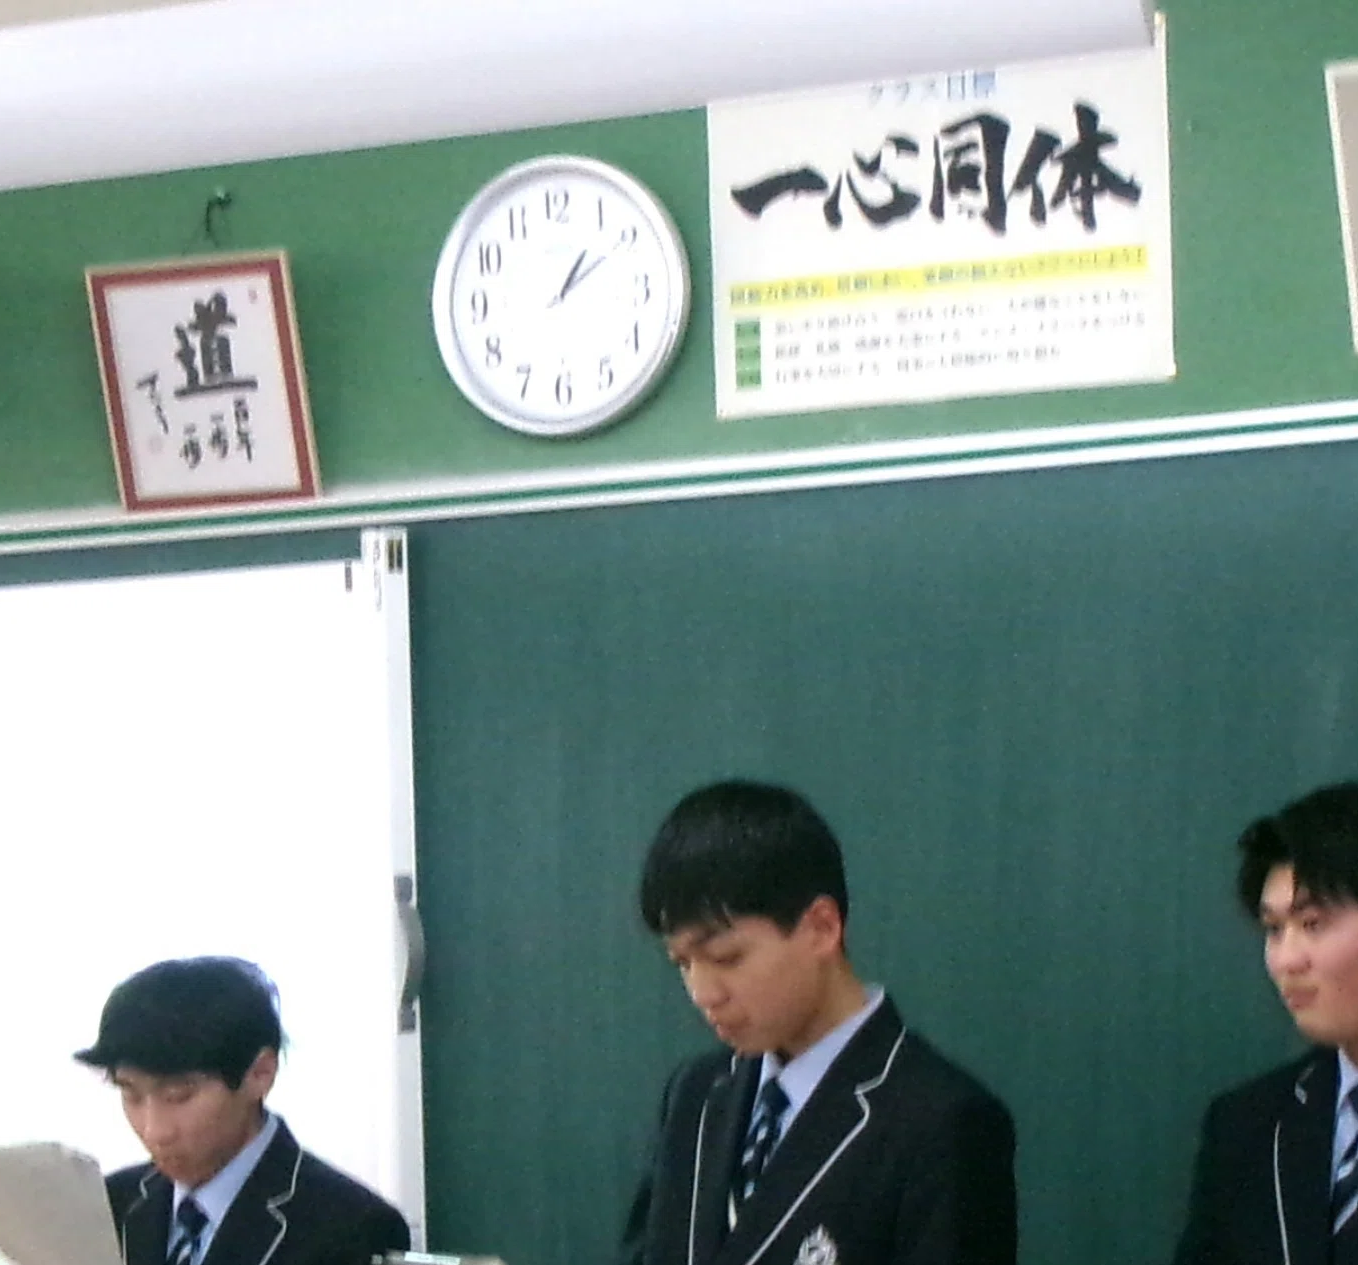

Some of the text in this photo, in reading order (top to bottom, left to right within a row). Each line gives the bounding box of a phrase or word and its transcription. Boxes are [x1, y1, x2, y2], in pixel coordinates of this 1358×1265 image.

[730, 98, 1141, 237] 一心同体
[509, 205, 527, 241] 11
[545, 190, 569, 224] 12
[479, 241, 502, 277] 10
[471, 288, 488, 325] 9
[173, 290, 259, 398] 道
[486, 335, 502, 370] 8
[516, 363, 531, 400] 7
[555, 371, 572, 405] 6
[598, 356, 614, 391] 5
